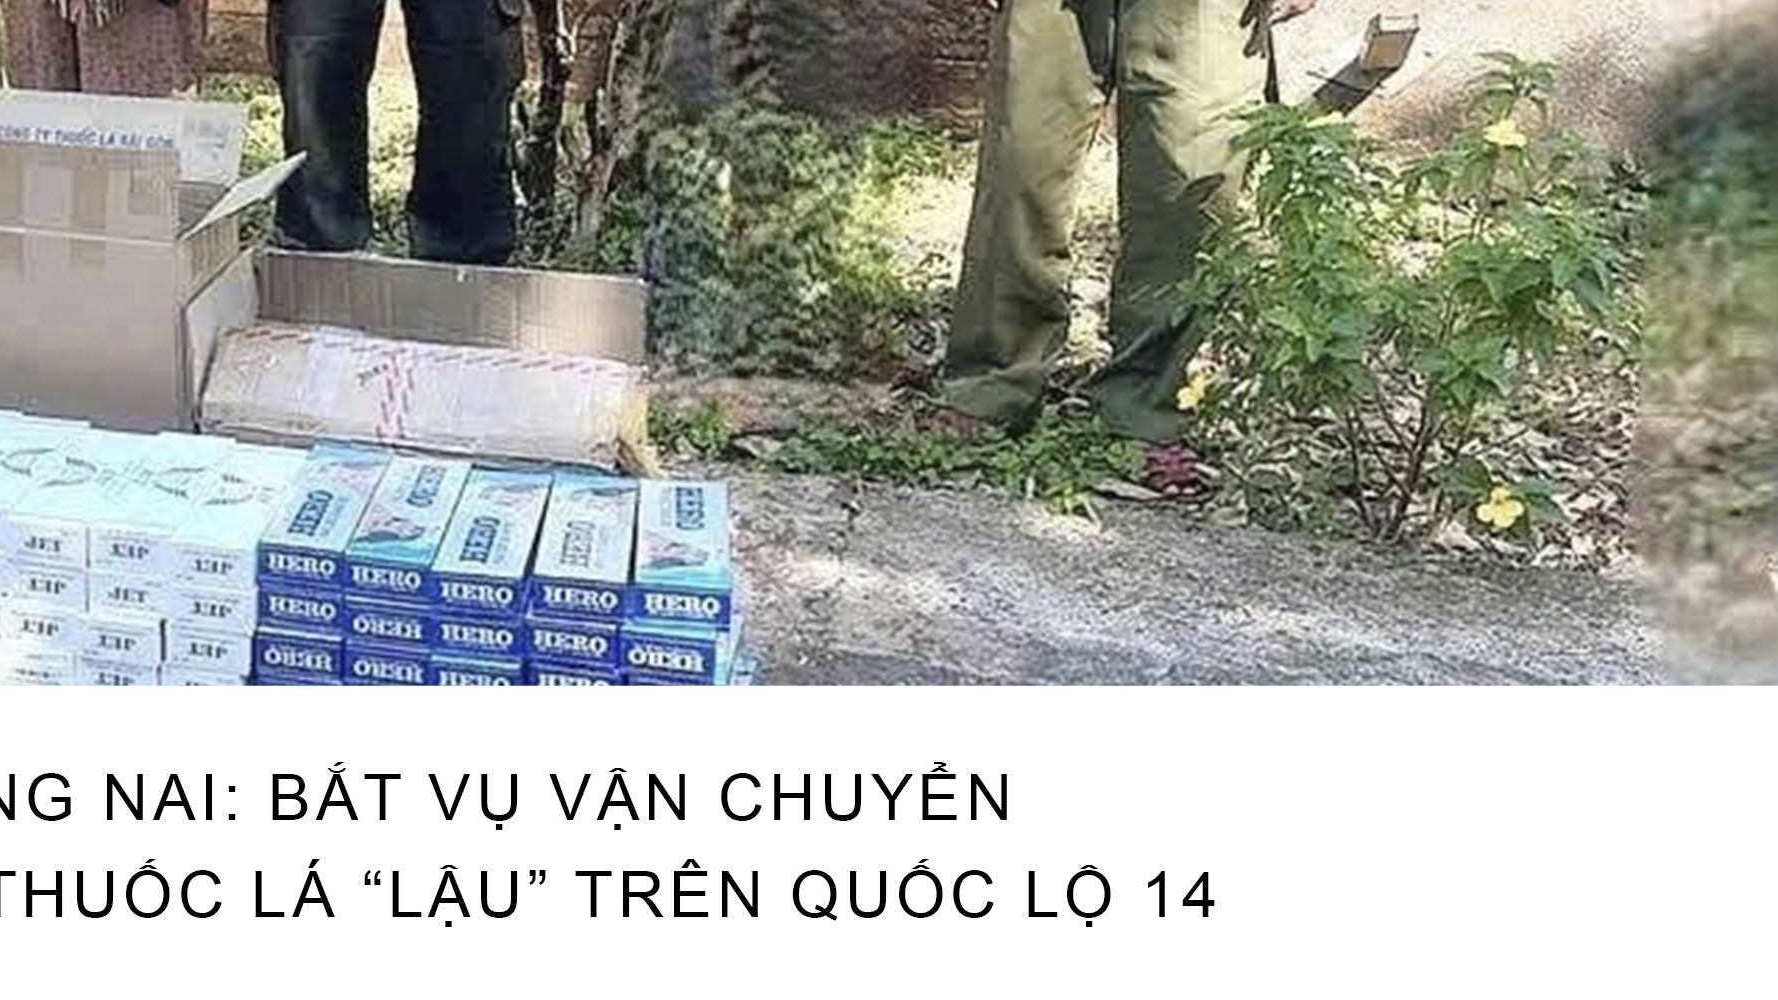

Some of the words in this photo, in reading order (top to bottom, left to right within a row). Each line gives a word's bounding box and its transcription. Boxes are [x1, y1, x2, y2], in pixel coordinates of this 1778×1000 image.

[268, 553, 336, 575] HERO
[351, 567, 421, 589] HERO
[441, 582, 513, 605] HERO
[542, 585, 619, 609] HERO
[644, 593, 720, 616] HERO
[269, 596, 336, 620] HERO
[353, 616, 421, 639] HERO
[441, 624, 513, 646] HERO
[533, 629, 607, 653] HERO
[264, 648, 332, 672] HERO
[628, 647, 704, 672] HERO
[353, 659, 423, 684] HERO
